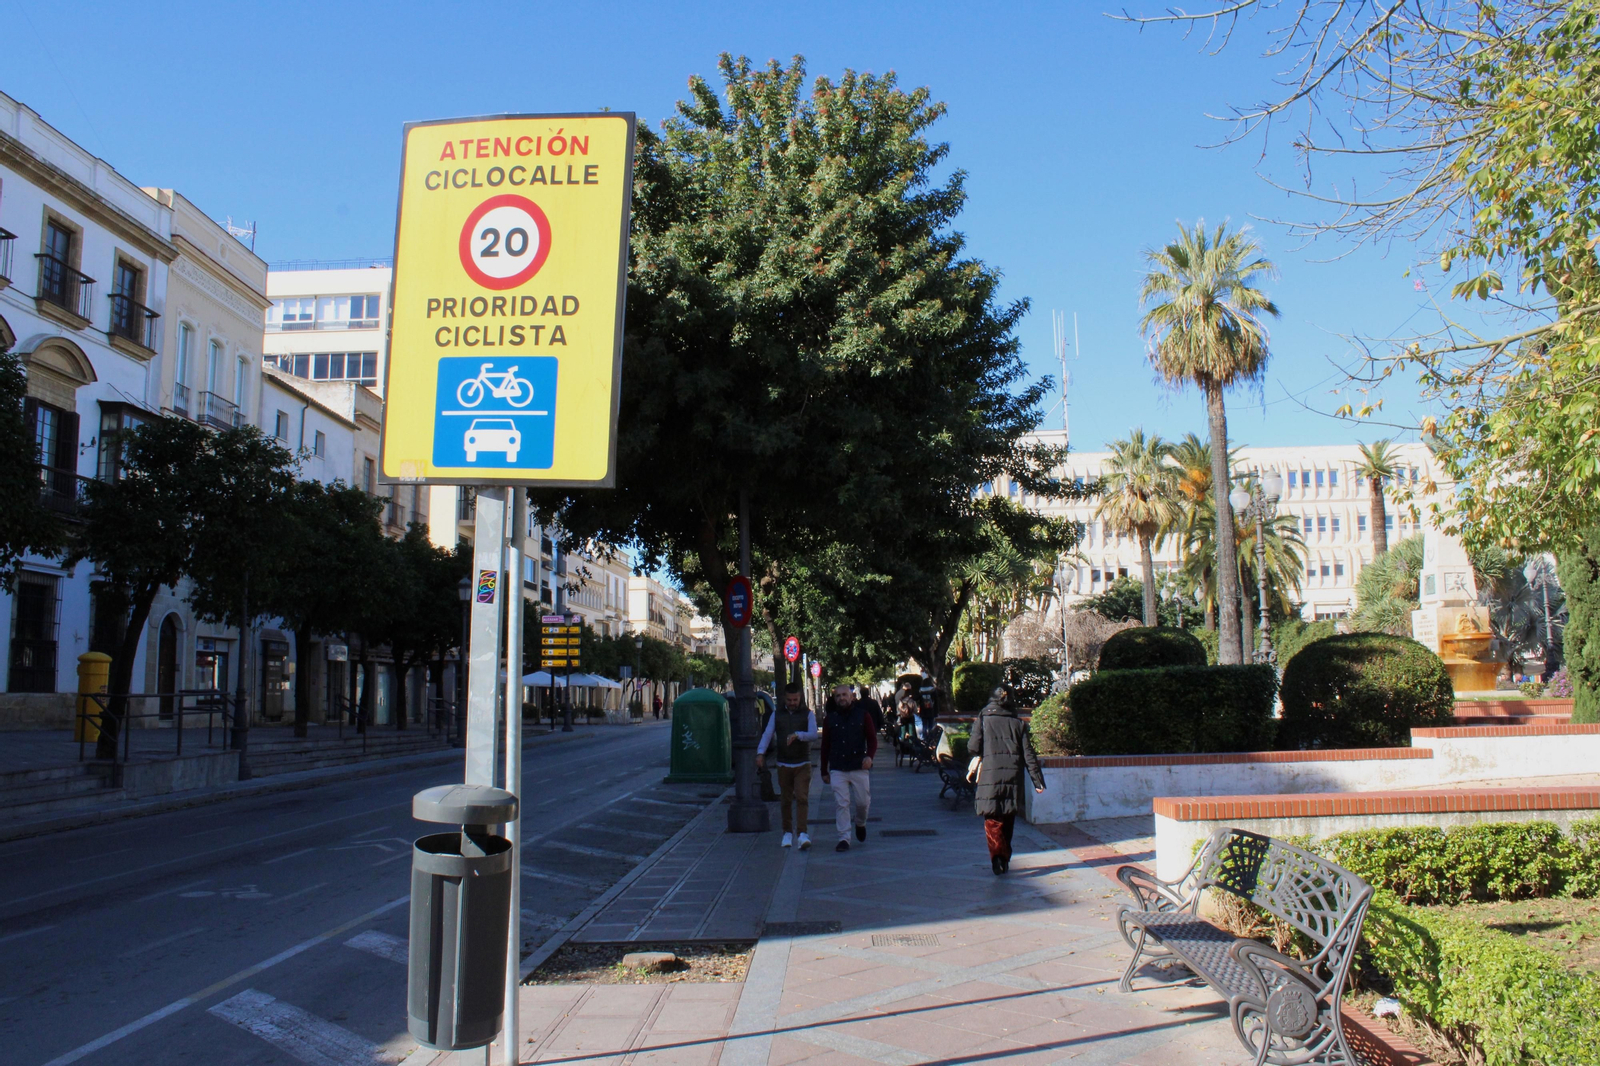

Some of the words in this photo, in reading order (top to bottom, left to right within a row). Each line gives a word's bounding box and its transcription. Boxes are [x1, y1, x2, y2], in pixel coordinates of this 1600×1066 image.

[439, 127, 589, 162] ATENCIÓN
[424, 164, 599, 191] CICLOCALLE
[480, 227, 529, 258] 20
[426, 295, 580, 319] PRIORIDAD
[434, 324, 568, 348] CICLISTA
